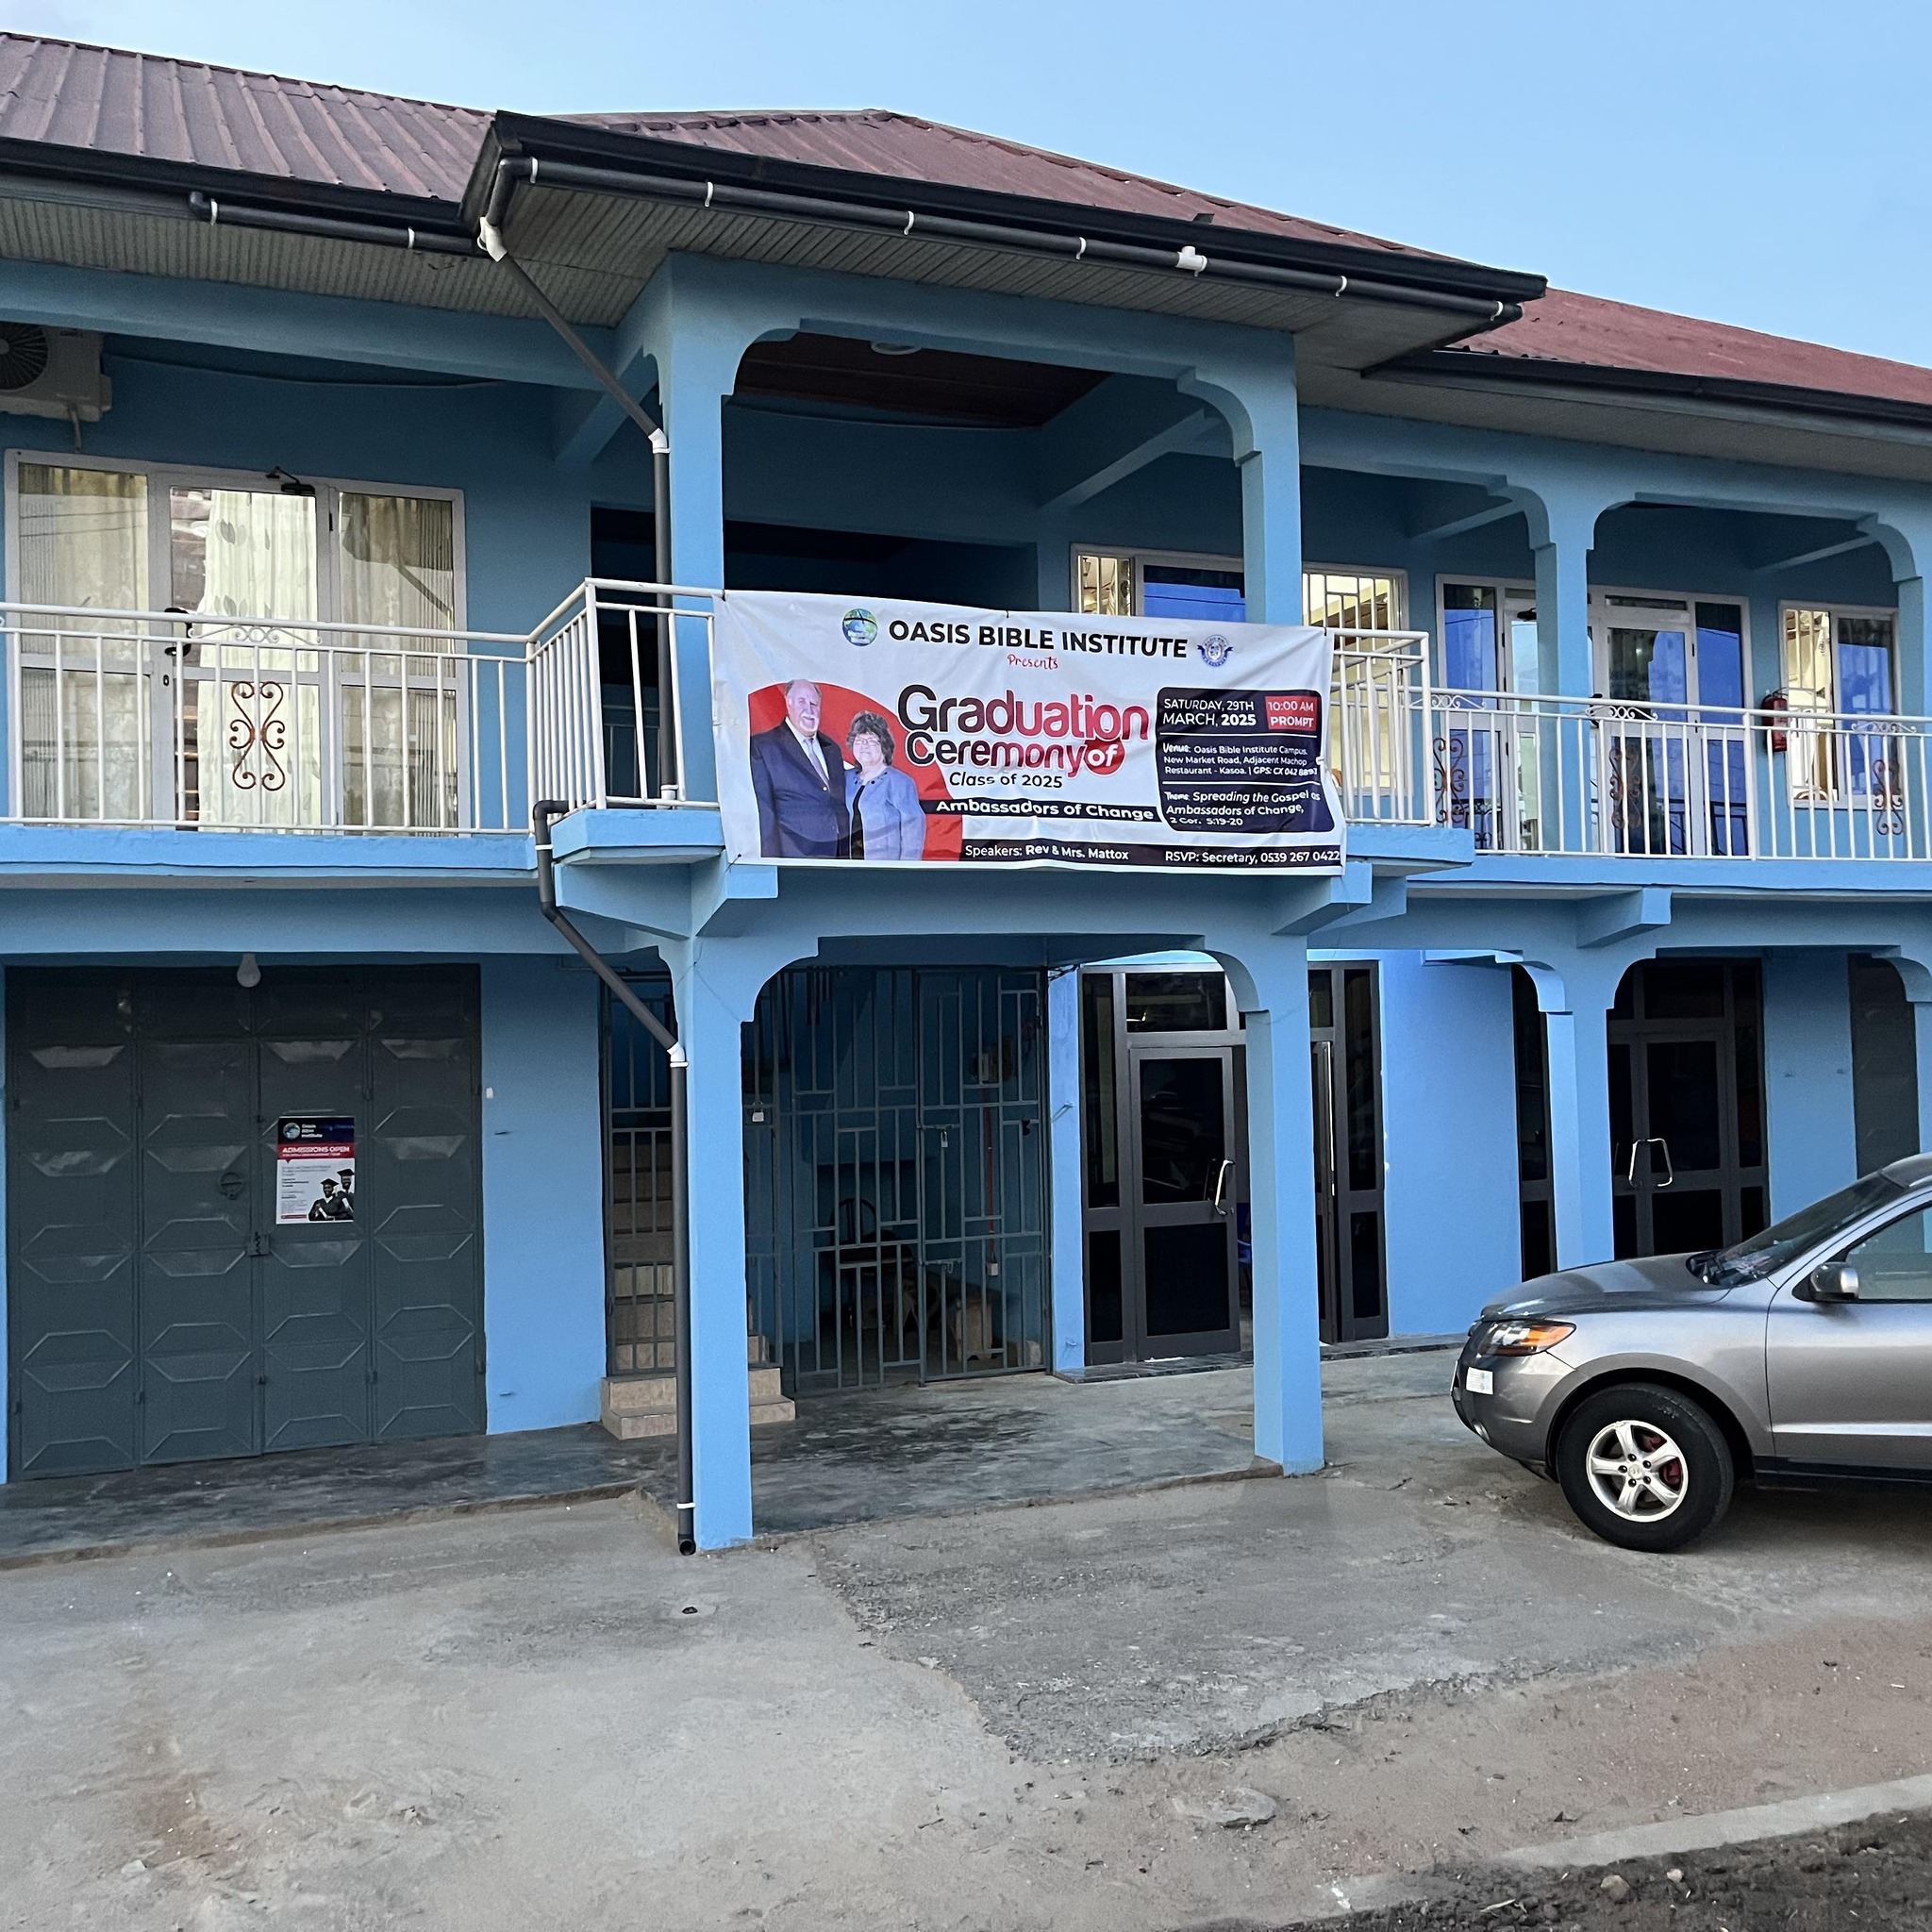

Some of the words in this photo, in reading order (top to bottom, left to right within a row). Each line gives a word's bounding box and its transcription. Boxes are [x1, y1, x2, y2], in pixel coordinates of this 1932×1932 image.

[889, 620, 970, 643] OASIS
[978, 626, 1055, 649] BIBLE
[1062, 631, 1189, 658] INSTITUTE
[1007, 654, 1058, 670] Presents
[898, 684, 1149, 740] Graduation
[1163, 698, 1224, 712] SATURDAY,
[1226, 700, 1255, 711] 29TH
[1269, 701, 1297, 711] 10:00
[1299, 702, 1314, 711] AM
[1163, 712, 1218, 727] MARCH,
[1221, 714, 1257, 726] 2025
[1271, 716, 1314, 727] PROMPT
[907, 731, 1085, 777] Ceremony
[1087, 744, 1118, 767] of
[1162, 742, 1191, 754] Venue:
[1194, 745, 1218, 754] Oasis
[1219, 745, 1241, 754] Bible
[1242, 745, 1277, 754] Institute
[1164, 756, 1184, 764] New
[1186, 756, 1216, 764] Market
[1217, 756, 1241, 765] Road,
[1243, 756, 1279, 765] Adjacent
[1280, 757, 1307, 767] Machop
[1165, 766, 1212, 774] Restaurant
[1219, 766, 1246, 774] Kasoa.
[949, 772, 995, 787] Class
[1000, 773, 1017, 785] of
[1022, 774, 1063, 789] 2025
[1192, 791, 1251, 805] Spreading
[1252, 792, 1269, 802] the
[1271, 790, 1308, 803] Gospel
[936, 800, 1059, 815] Ambassadors
[1063, 804, 1082, 815] of
[1085, 806, 1154, 821] Change
[1166, 805, 1242, 815] Ambassadors
[1244, 806, 1256, 815] of
[1257, 804, 1304, 815] Change,
[965, 844, 1023, 858] Speakers:
[1025, 844, 1050, 856] Rev
[1051, 846, 1059, 856] &
[1061, 846, 1086, 858] Mrs.
[1088, 848, 1129, 860] Mattox
[1165, 851, 1200, 862] RSVP:
[1202, 852, 1258, 865] Secretary,
[1260, 853, 1287, 862] 0539
[1290, 852, 1309, 861] 267
[1312, 851, 1340, 861] 0422
